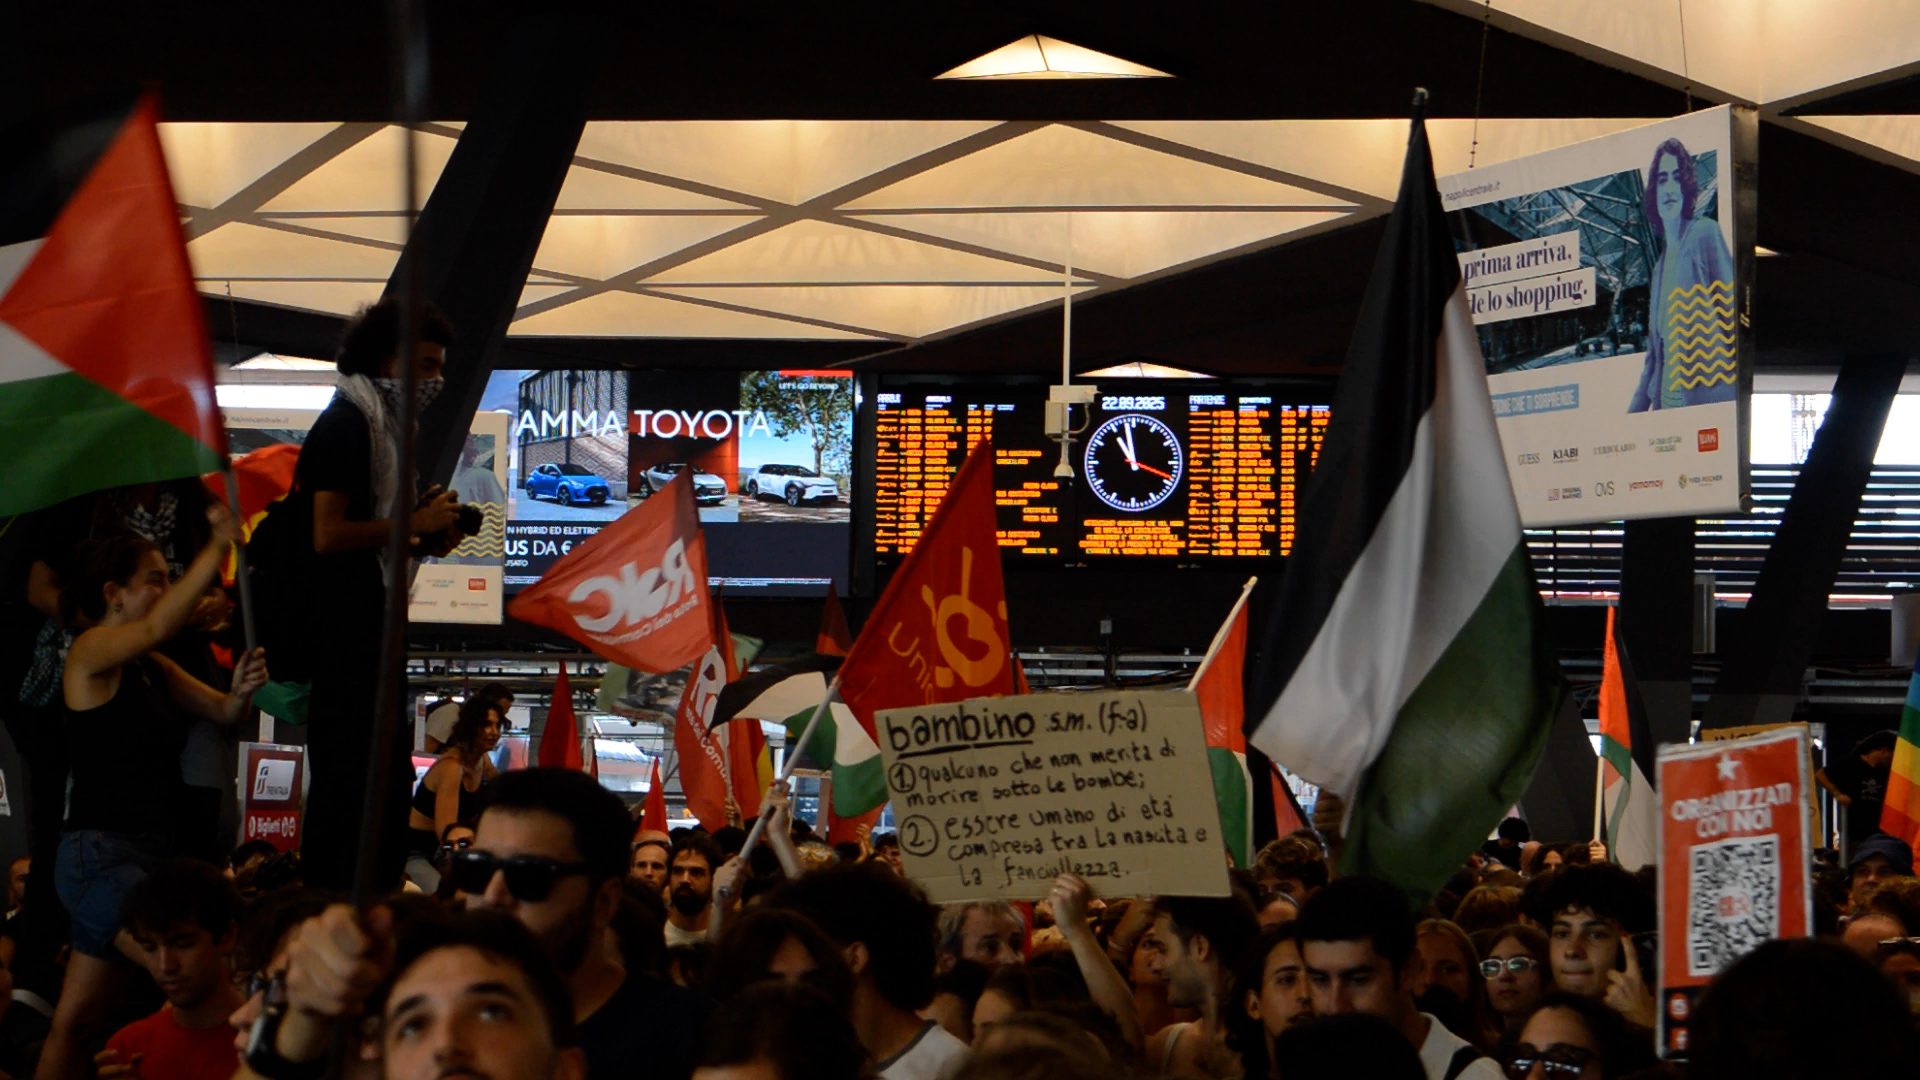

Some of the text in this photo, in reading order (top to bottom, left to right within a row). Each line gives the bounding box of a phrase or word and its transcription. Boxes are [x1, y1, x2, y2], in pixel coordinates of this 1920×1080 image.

[1463, 240, 1573, 287] prima arriva.
[1487, 290, 1502, 311] lo
[1505, 275, 1588, 313] shopping.
[1102, 396, 1165, 410] 22.09.2025
[494, 409, 772, 439] AMMA TOYOTA
[1552, 447, 1579, 459] KIABI
[1594, 480, 1615, 497] OVS
[516, 526, 548, 535] HYBRID
[549, 526, 562, 535] ED
[533, 540, 558, 555] DA
[885, 703, 1036, 752] bambino
[919, 757, 998, 792] qualcuno
[1010, 751, 1043, 775] che
[1050, 751, 1082, 767] non
[1090, 741, 1152, 764] merita
[1159, 736, 1176, 757] di
[906, 789, 979, 807] morire
[992, 780, 1041, 799] sotto
[1072, 768, 1145, 792] bombe;
[1671, 782, 1792, 821] ORGANIZZATI
[944, 812, 1021, 840] essere
[1028, 807, 1095, 827] umano
[1106, 800, 1127, 823] di
[1733, 807, 1773, 832] NOI
[948, 837, 1043, 862] compresa
[1051, 829, 1088, 851] tra
[1123, 823, 1189, 845] nascita
[1195, 826, 1208, 843] e
